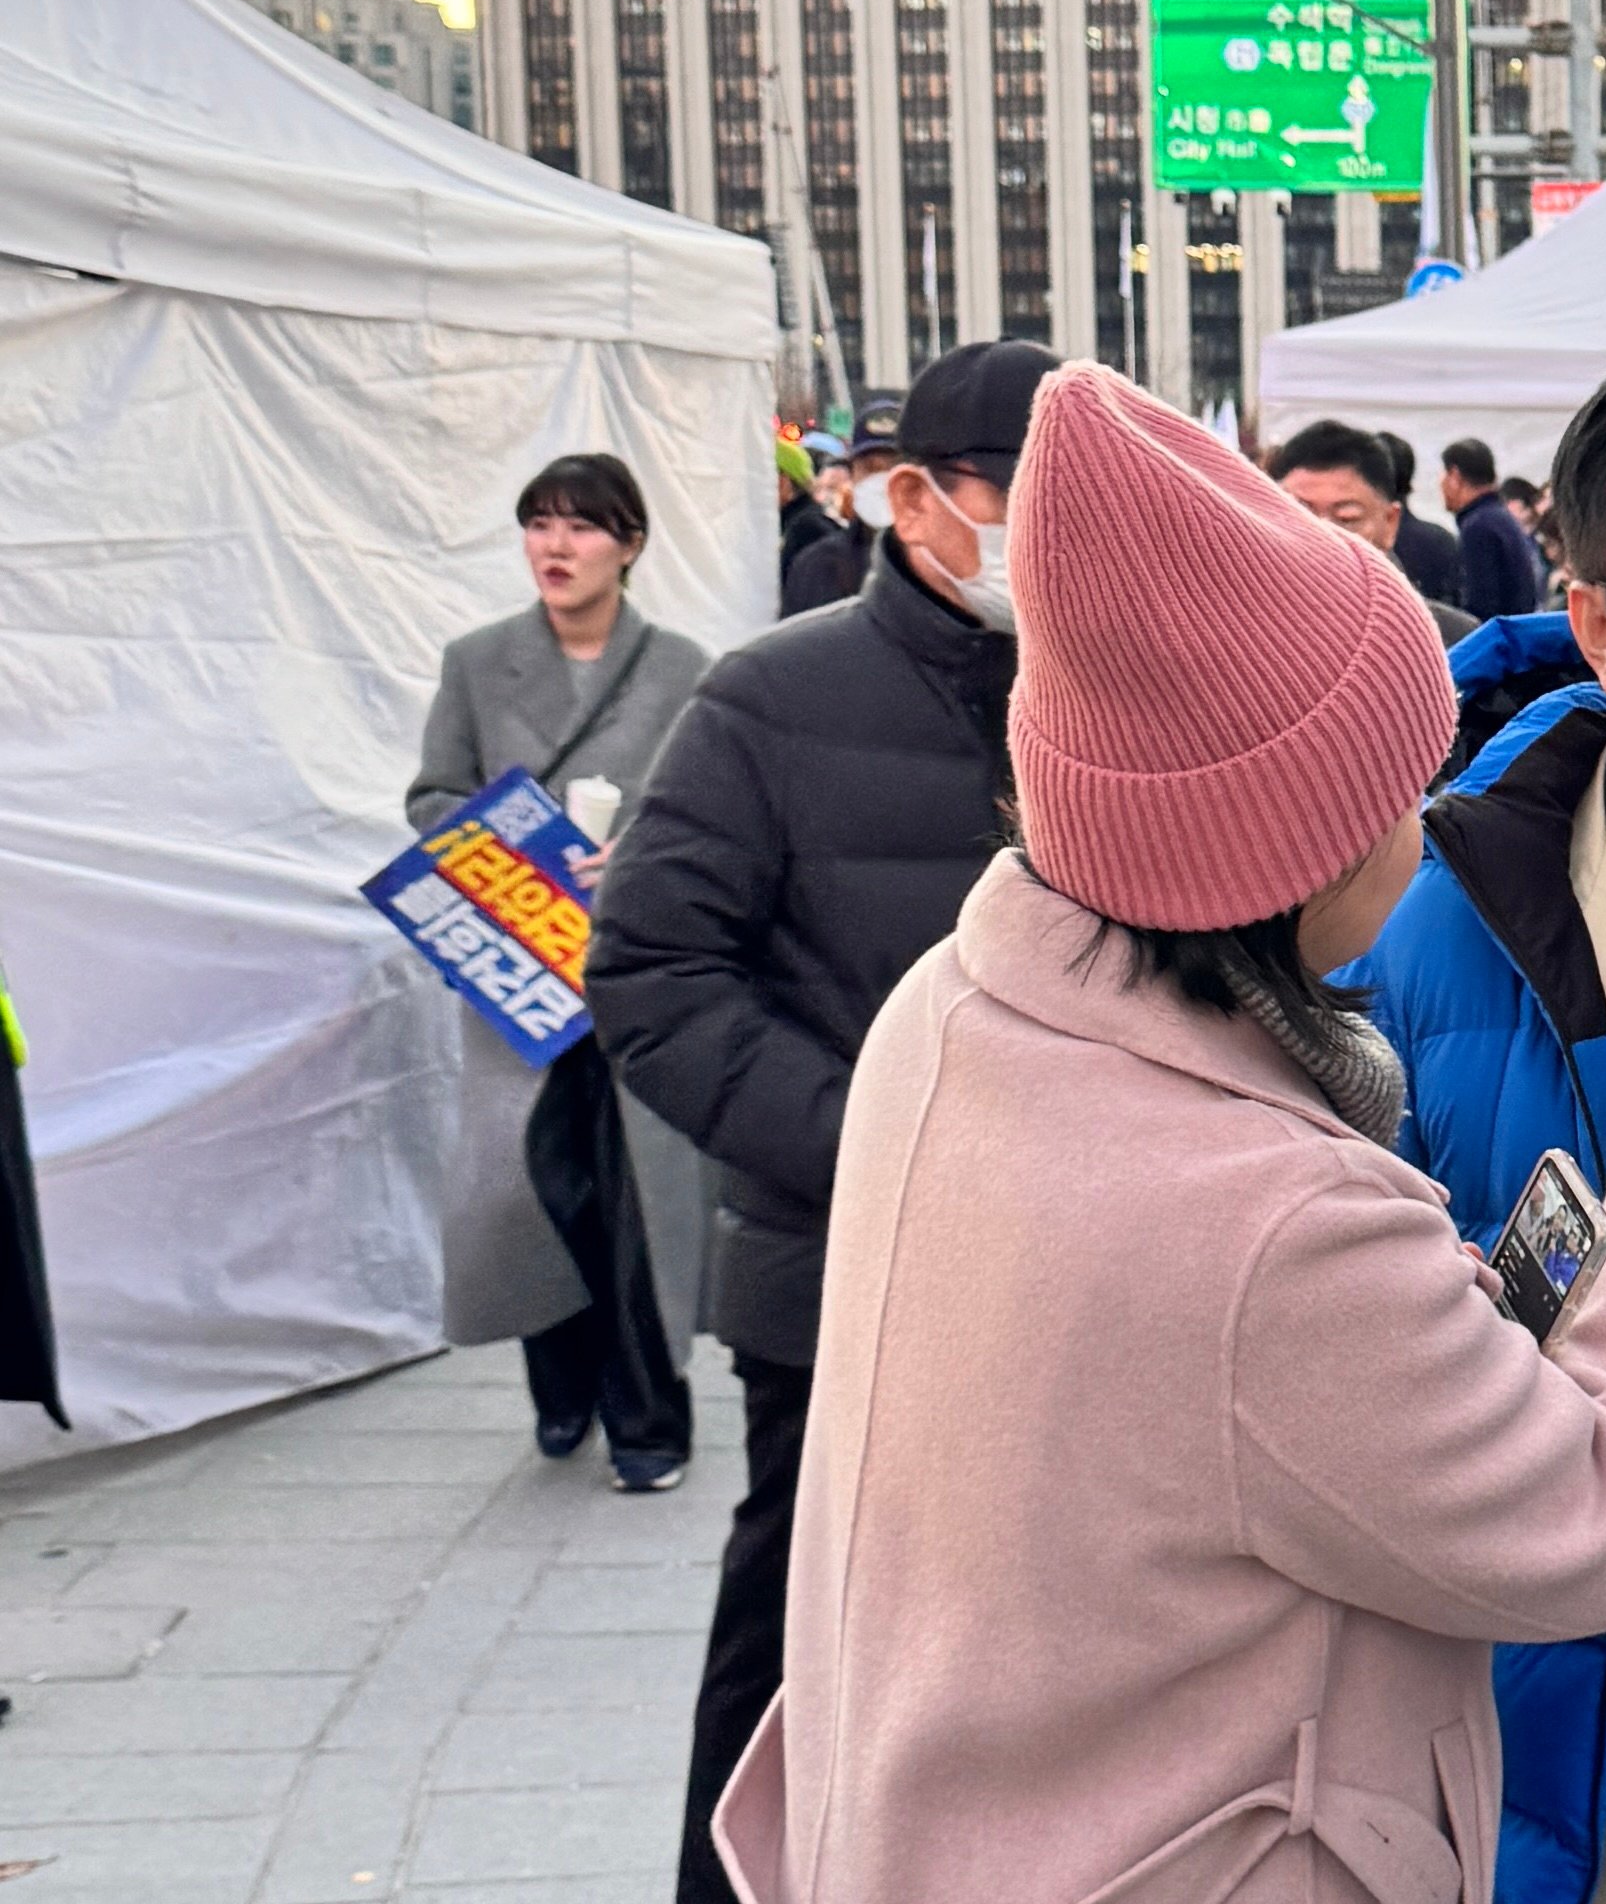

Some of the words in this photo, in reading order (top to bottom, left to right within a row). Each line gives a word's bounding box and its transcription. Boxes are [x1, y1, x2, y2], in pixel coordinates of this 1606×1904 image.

[1167, 104, 1220, 135] 시청
[1166, 137, 1211, 163] City
[422, 820, 592, 995] 검하라!
